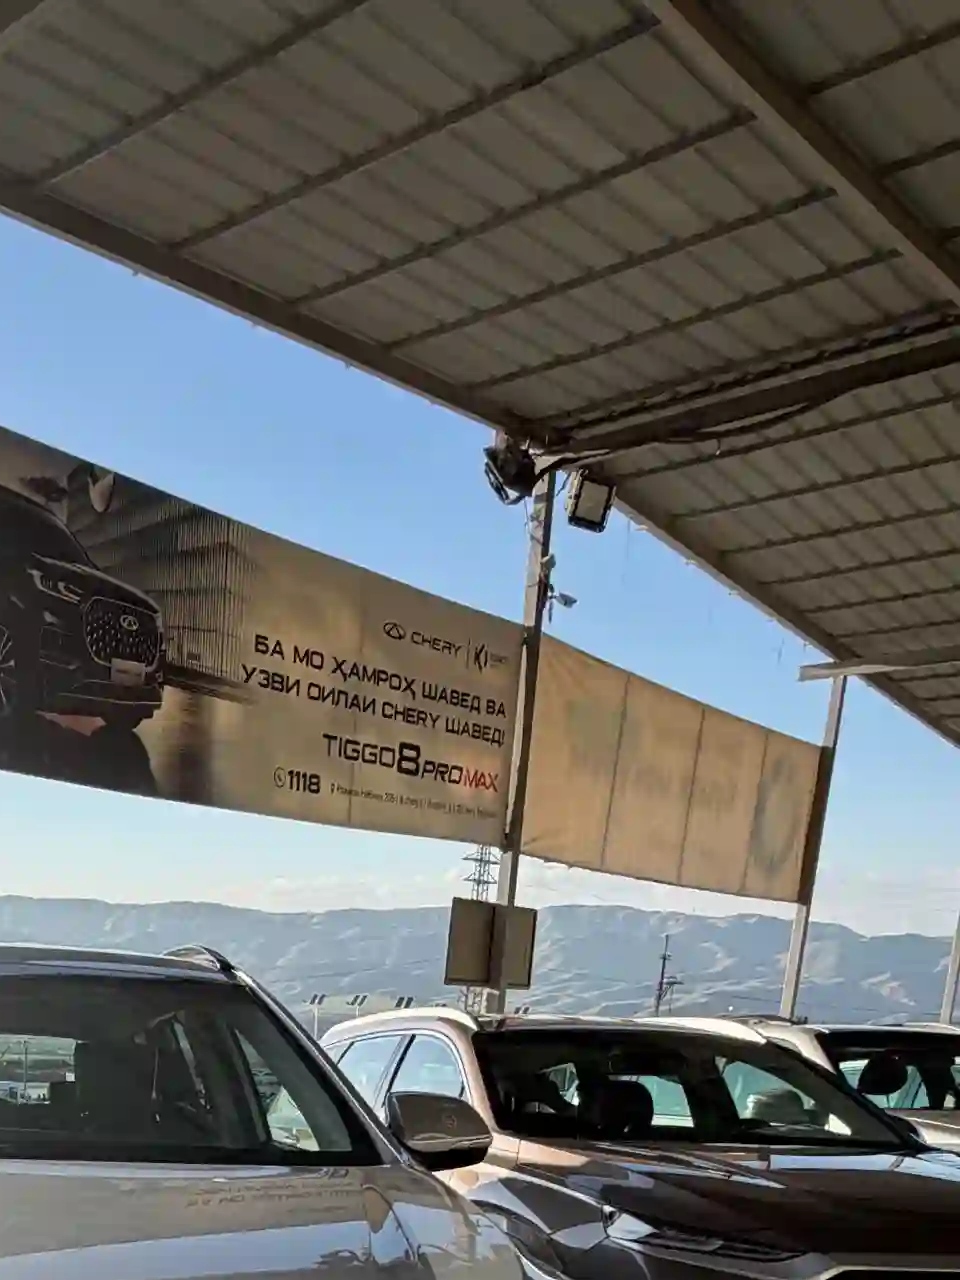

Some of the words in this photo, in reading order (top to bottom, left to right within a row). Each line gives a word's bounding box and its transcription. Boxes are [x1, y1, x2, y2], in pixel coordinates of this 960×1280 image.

[411, 631, 463, 658] CHERY
[254, 633, 285, 661] БА
[293, 646, 324, 669] МО
[422, 683, 481, 714] ШАВЕД
[485, 698, 506, 718] ВА
[242, 664, 300, 697] УЗВИ
[307, 682, 376, 716] ОИЛАИ
[382, 702, 441, 729] CHERY
[445, 717, 506, 748] ШАВЕД!
[288, 769, 321, 794] 1118
